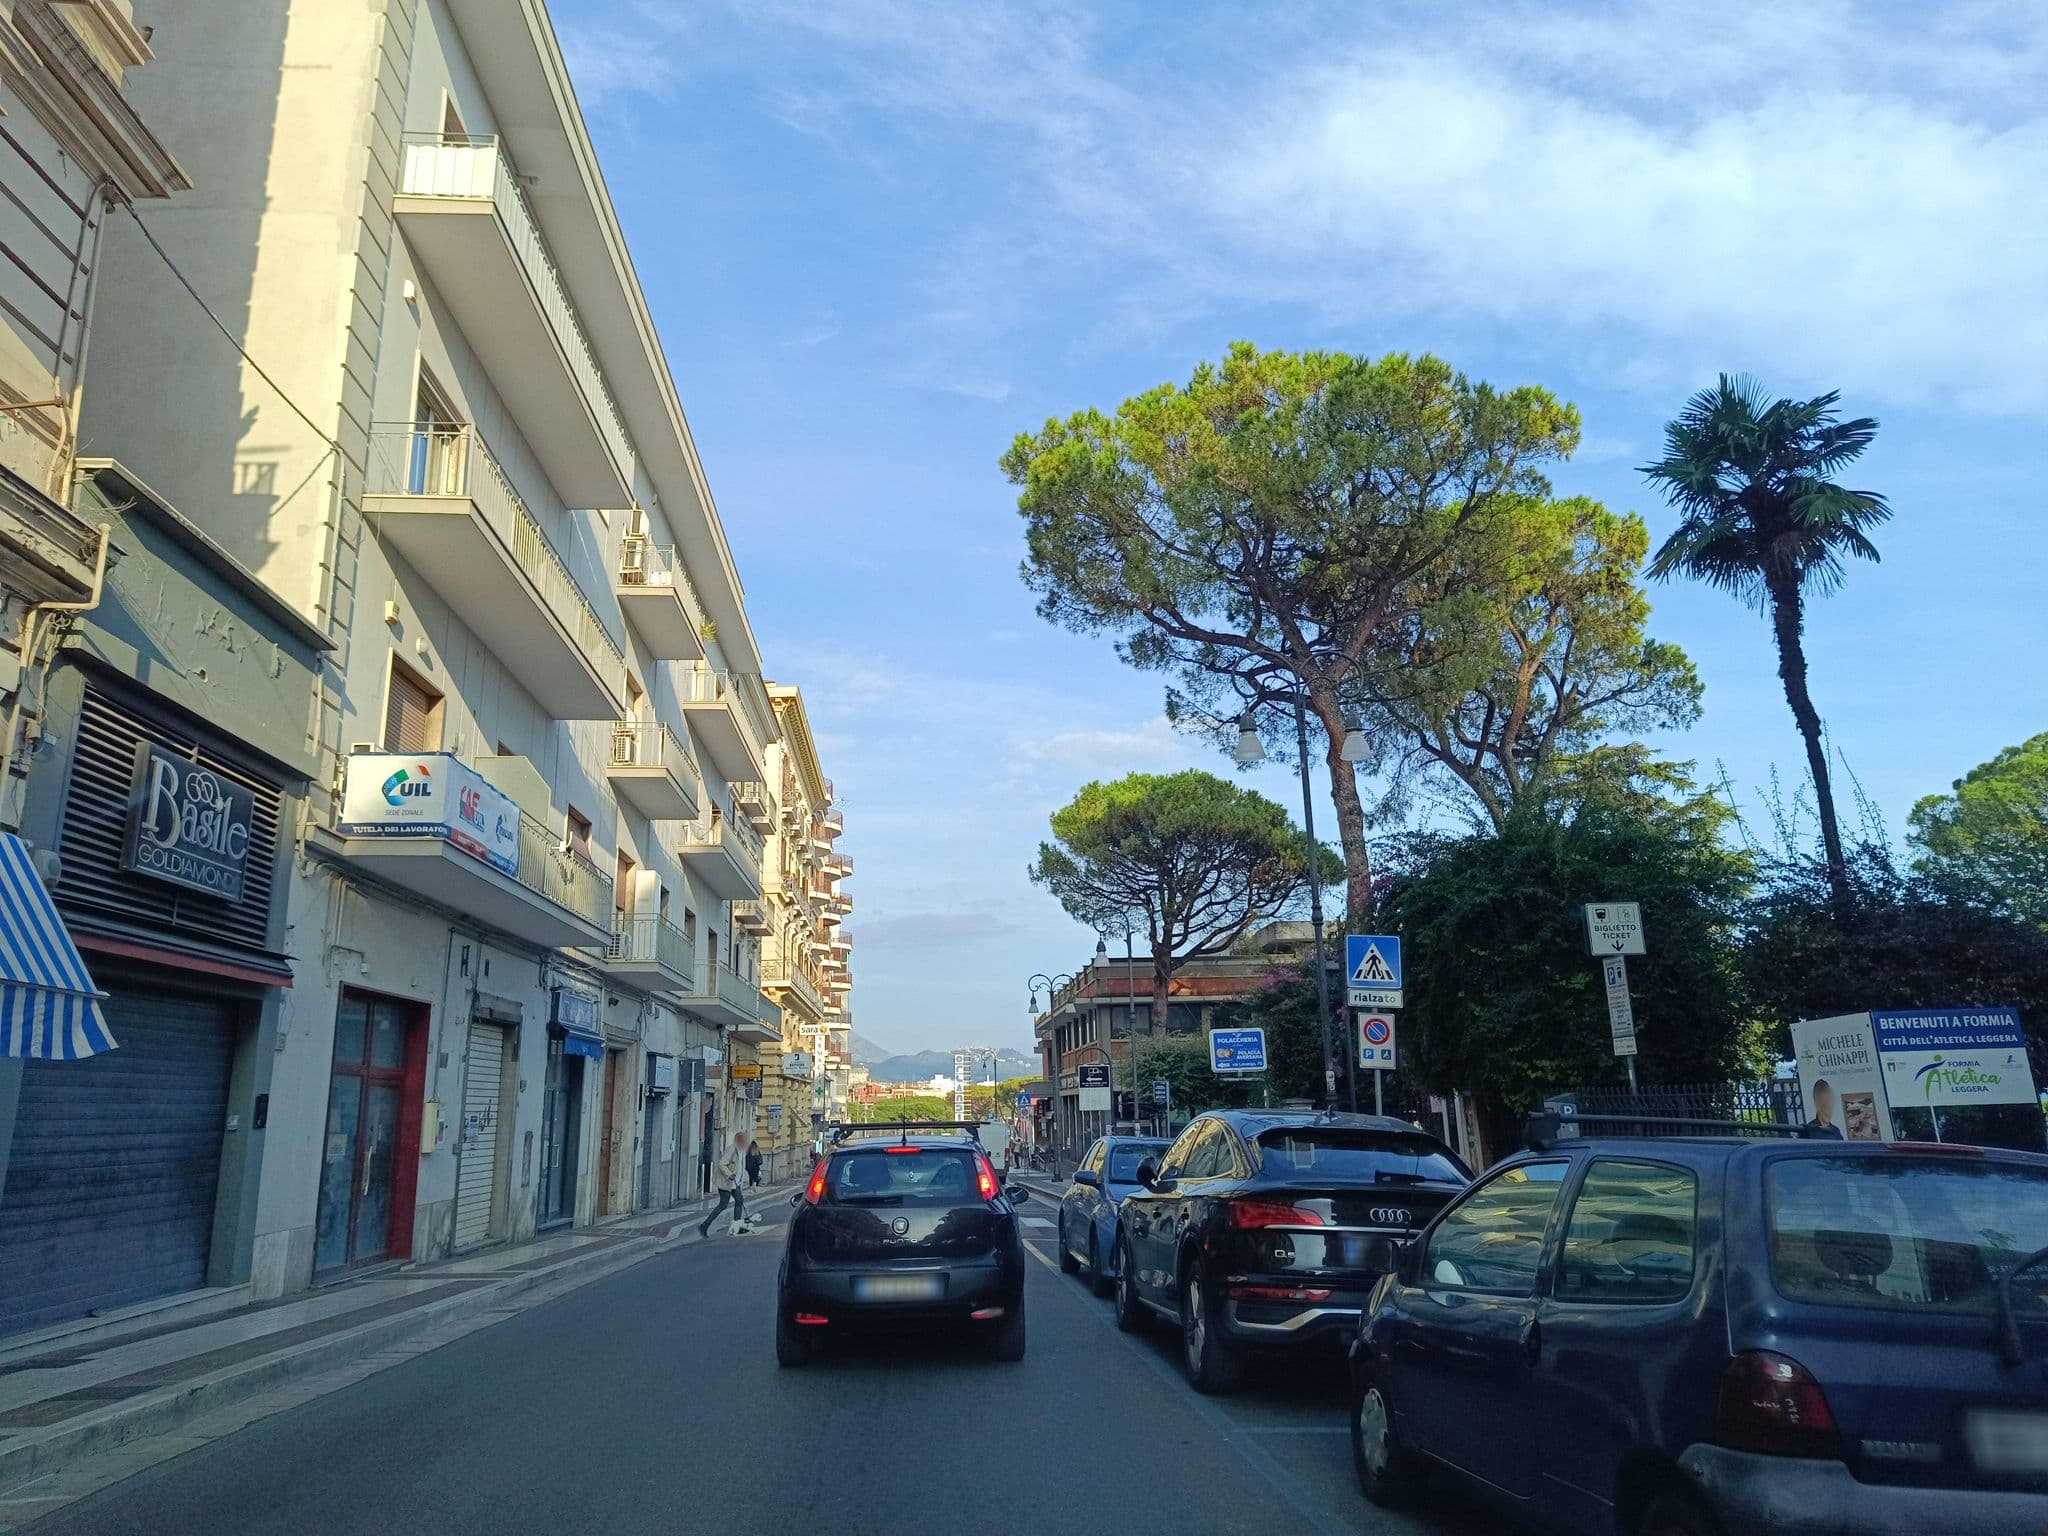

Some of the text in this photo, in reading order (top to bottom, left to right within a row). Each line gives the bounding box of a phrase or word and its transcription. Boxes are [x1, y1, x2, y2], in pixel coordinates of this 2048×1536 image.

[400, 783, 431, 797] UIL
[142, 754, 248, 860] Basile
[1594, 924, 1636, 932] BIGLIETTO
[1354, 993, 1396, 1003] rialzato
[1880, 1014, 2014, 1030] BENVENUTI A FORMIA
[801, 1026, 818, 1034] sara
[1818, 1033, 1864, 1051] MICHELE
[1883, 1034, 2018, 1046] CITTÀ DELL'ATLETICA LEGGERA
[1818, 1050, 1869, 1068] CHINAPPI
[1947, 1060, 1980, 1068] FORMIA
[1925, 1067, 2002, 1101] Atletica
[1951, 1085, 1989, 1093] LEGGERA
